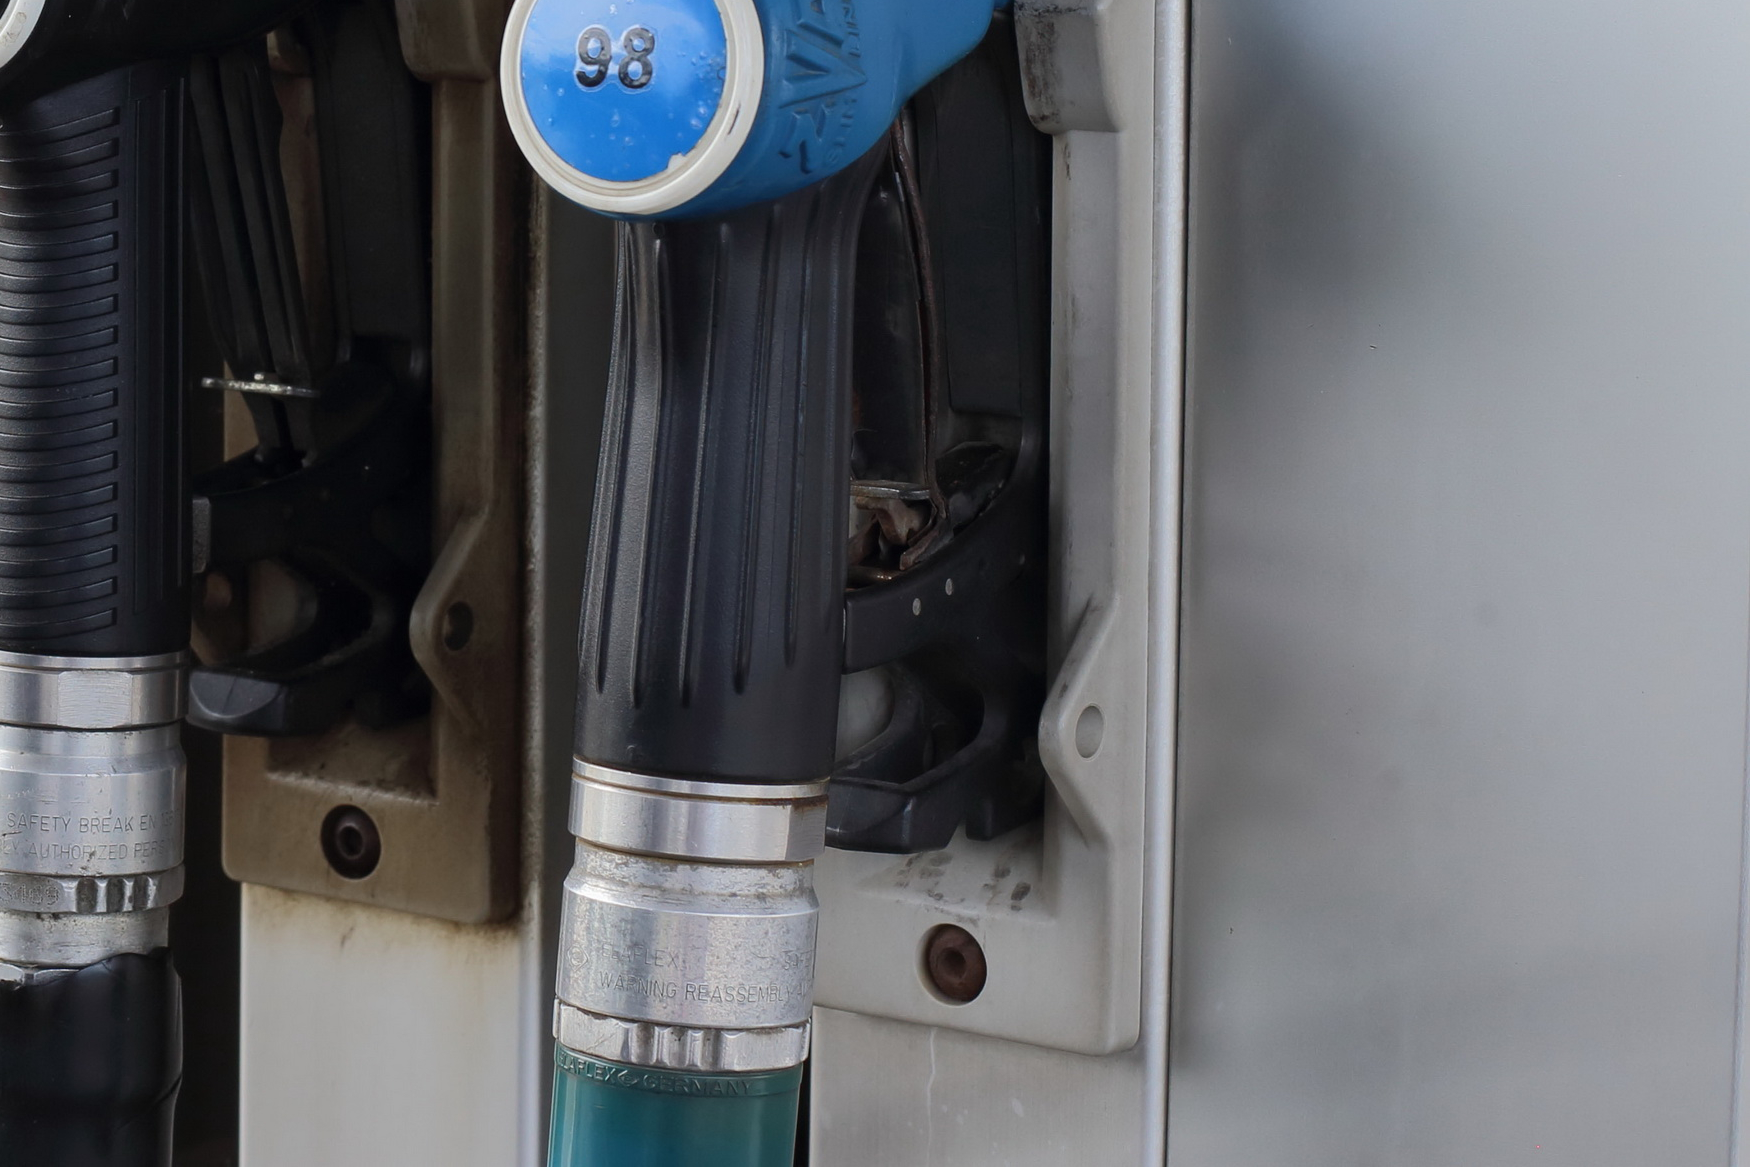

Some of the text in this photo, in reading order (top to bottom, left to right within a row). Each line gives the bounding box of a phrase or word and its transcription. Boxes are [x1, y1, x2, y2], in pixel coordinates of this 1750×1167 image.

[575, 25, 656, 90] 98
[7, 811, 71, 833] SAFETY
[79, 814, 134, 834] BREAK
[140, 813, 156, 831] EN
[28, 841, 128, 861] AUTHORIZED
[601, 942, 679, 969] ELAFLEX
[599, 971, 678, 999] WARNING
[685, 982, 792, 1004] REASSEMBLY
[558, 1051, 754, 1095] ELAFLEX GERMANY
